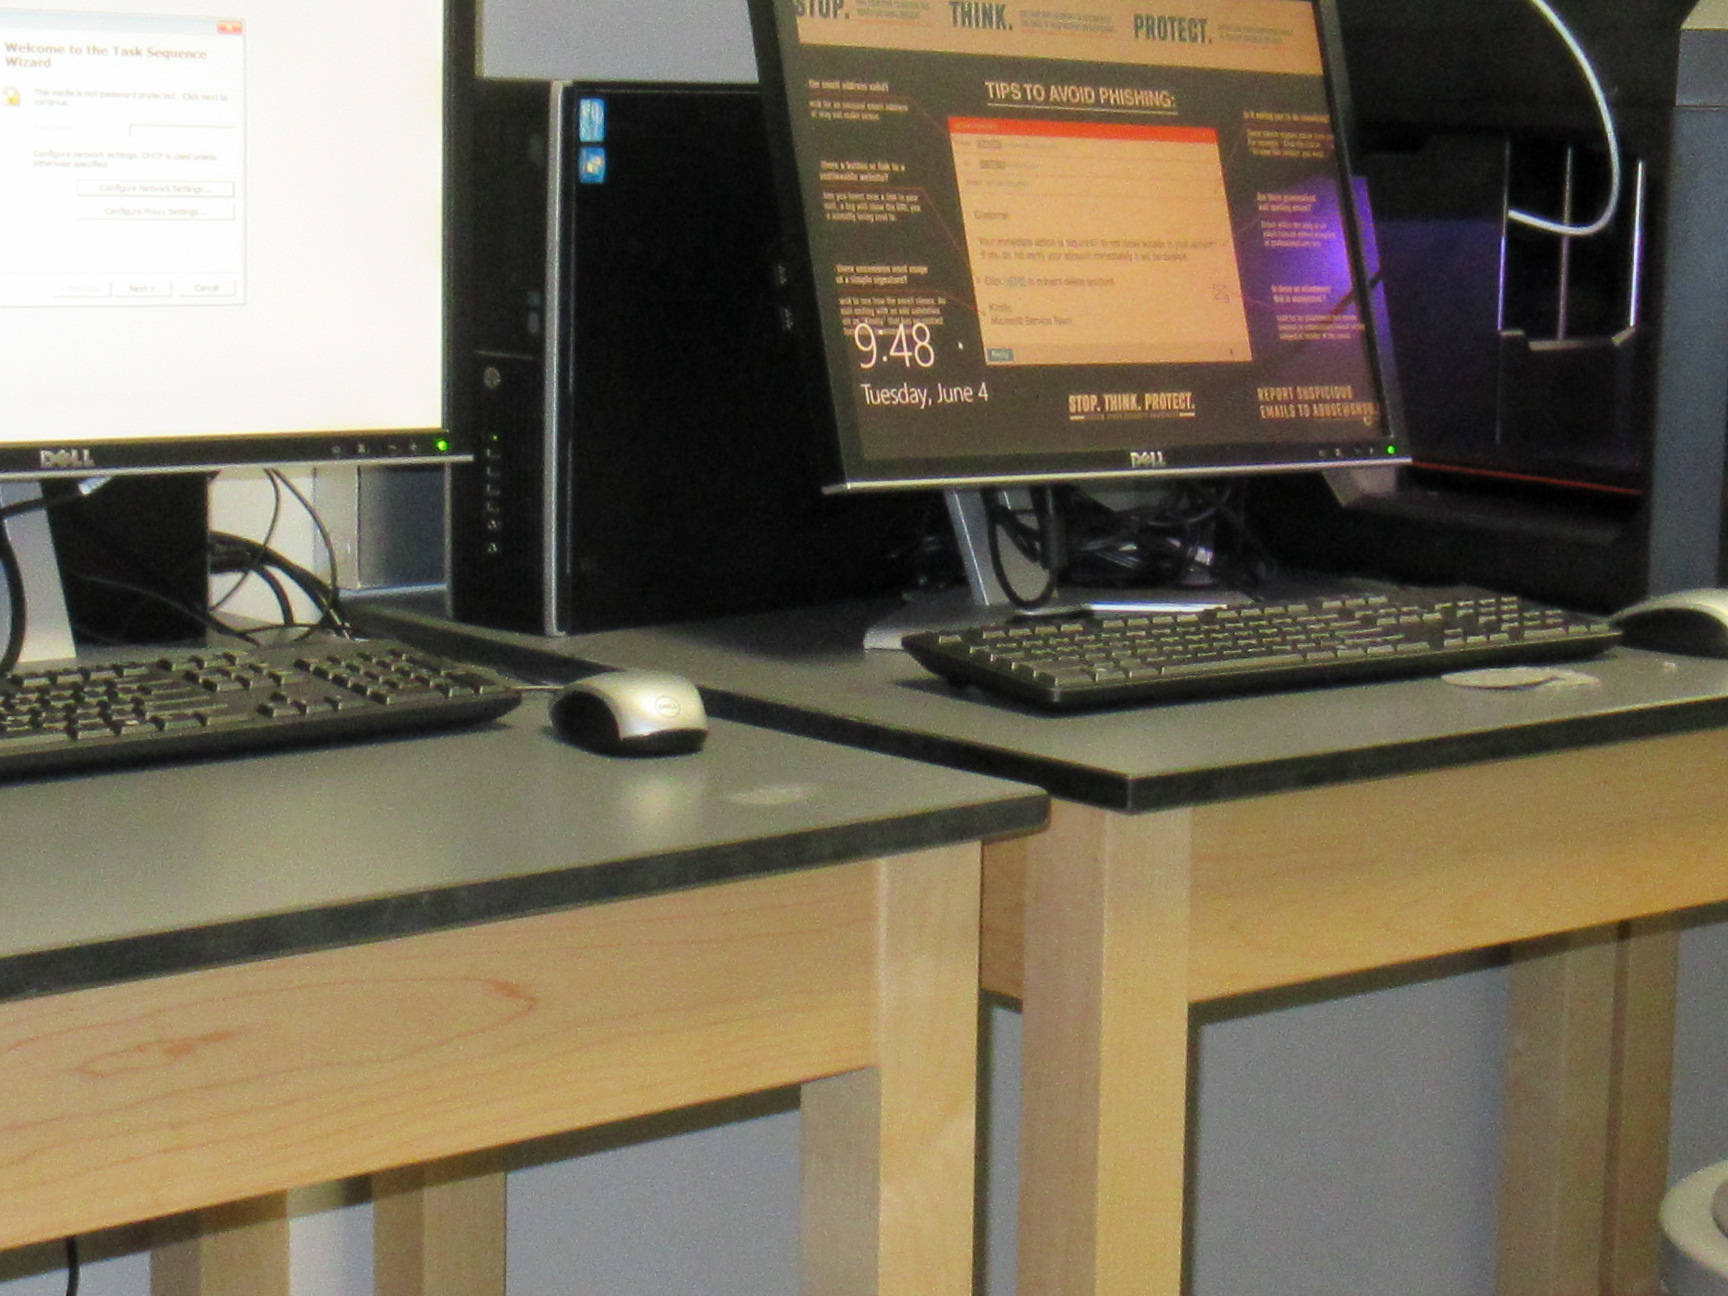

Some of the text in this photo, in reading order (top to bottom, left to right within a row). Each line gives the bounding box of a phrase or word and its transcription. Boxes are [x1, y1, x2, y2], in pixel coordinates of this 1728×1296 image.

[949, 0, 1013, 30] THINK.
[1133, 13, 1213, 44] PROTECT.
[5, 42, 207, 61] Welcome to the Task Sequence
[5, 56, 52, 68] Wizard
[985, 81, 1176, 108] TIPS TO AVOID PHISHING:
[853, 322, 935, 369] 9:48
[860, 382, 989, 409] Tuesday, June 4
[1068, 391, 1196, 413] STOP. THINK. PROTECT.
[39, 448, 96, 468] DELL
[1128, 450, 1167, 468] DELL
